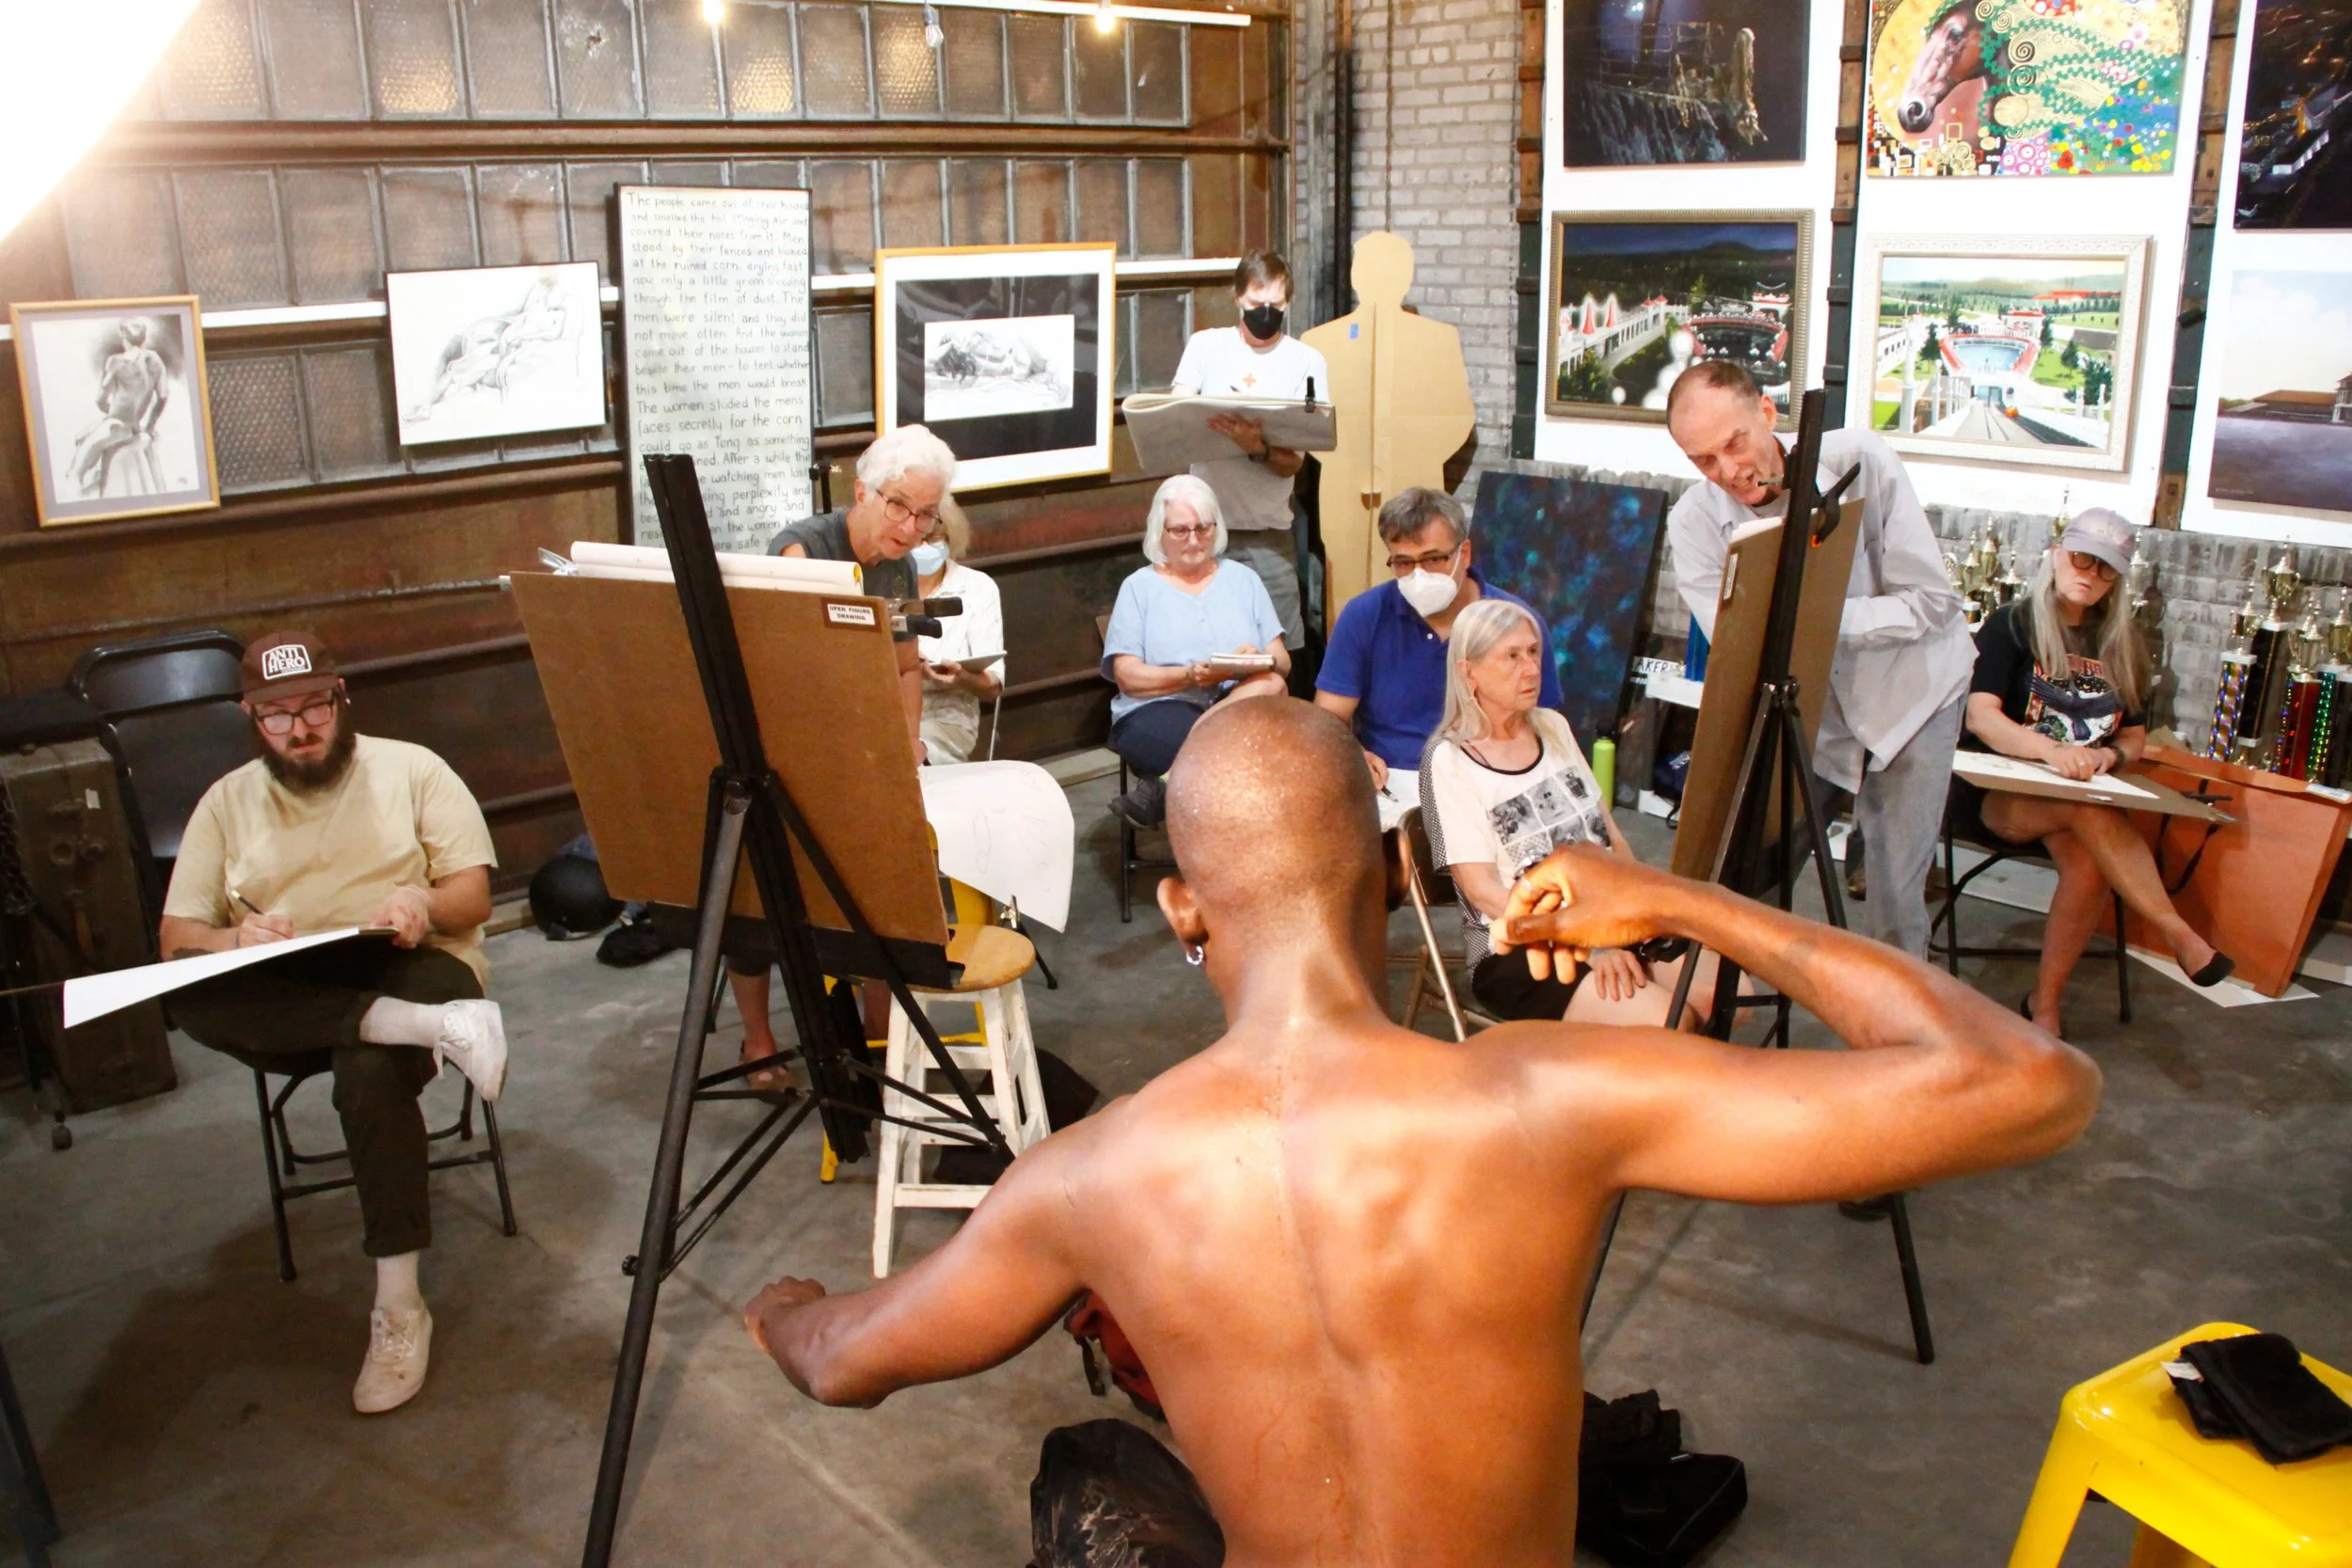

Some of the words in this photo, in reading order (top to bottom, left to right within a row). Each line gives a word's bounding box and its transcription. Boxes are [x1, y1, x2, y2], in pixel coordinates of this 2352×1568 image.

[627, 192, 650, 207] The
[655, 194, 684, 210] people
[691, 198, 716, 208] came
[723, 199, 738, 209] out
[743, 198, 752, 208] of
[632, 212, 648, 222] and
[691, 213, 705, 223] the
[772, 215, 788, 225] air
[630, 226, 671, 236] covered
[679, 227, 704, 238] their
[708, 231, 735, 240] noses
[740, 229, 762, 241] from
[783, 230, 804, 245] Men
[632, 242, 661, 252] stood
[673, 242, 683, 257] by
[691, 241, 713, 254] their
[756, 246, 774, 257] and
[778, 246, 808, 257] looked
[632, 259, 644, 269] at
[651, 258, 667, 270] the
[675, 260, 707, 271] ruined
[746, 261, 779, 277] drying
[783, 260, 803, 272] fast
[632, 277, 653, 286] now
[661, 275, 683, 290] only
[689, 277, 696, 286] a
[703, 275, 728, 287] little
[736, 277, 764, 293] green
[633, 292, 672, 309] through
[679, 293, 696, 303] the
[703, 292, 729, 304] film
[737, 292, 747, 304] of
[782, 291, 803, 304] The
[633, 312, 660, 323] men
[663, 312, 695, 323] were
[703, 310, 735, 324] silent
[741, 313, 760, 324] and
[766, 312, 787, 327] they
[790, 310, 806, 322] did
[634, 328, 653, 341] not
[659, 330, 689, 341] move
[760, 326, 776, 338] the
[634, 348, 664, 358] came
[668, 345, 686, 356] out
[694, 342, 705, 356] of
[710, 342, 729, 356] the
[770, 341, 780, 354] to
[634, 363, 668, 377] beside
[674, 361, 695, 374] their
[738, 358, 749, 371] to
[754, 359, 773, 370] feel
[635, 383, 658, 395] this
[663, 381, 688, 393] time
[693, 379, 709, 391] the
[718, 381, 741, 391] men
[747, 377, 775, 388] would
[780, 377, 807, 388] break
[636, 401, 659, 414] The
[662, 402, 704, 414] women
[708, 397, 749, 411] studied
[754, 395, 771, 408] the
[637, 420, 671, 436] faces
[678, 416, 723, 436] secretly
[730, 414, 748, 430] for
[753, 413, 771, 427] the
[775, 415, 803, 425] corn
[638, 438, 671, 452] could
[678, 442, 691, 454] go
[697, 440, 708, 450] as
[715, 435, 740, 453] long
[746, 436, 759, 447] as
[763, 433, 810, 452] something
[723, 451, 749, 466] After
[754, 455, 760, 464] a
[765, 450, 790, 464] while
[710, 470, 760, 487] watching
[764, 470, 786, 480] men
[732, 483, 788, 506] perplexity
[792, 483, 811, 496] and
[718, 504, 739, 518] and
[746, 504, 777, 520] angry
[784, 499, 804, 511] and
[727, 519, 744, 533] the
[746, 521, 781, 532] women
[738, 533, 760, 549] safe
[269, 647, 299, 660] ANTI
[268, 657, 305, 673] HERO
